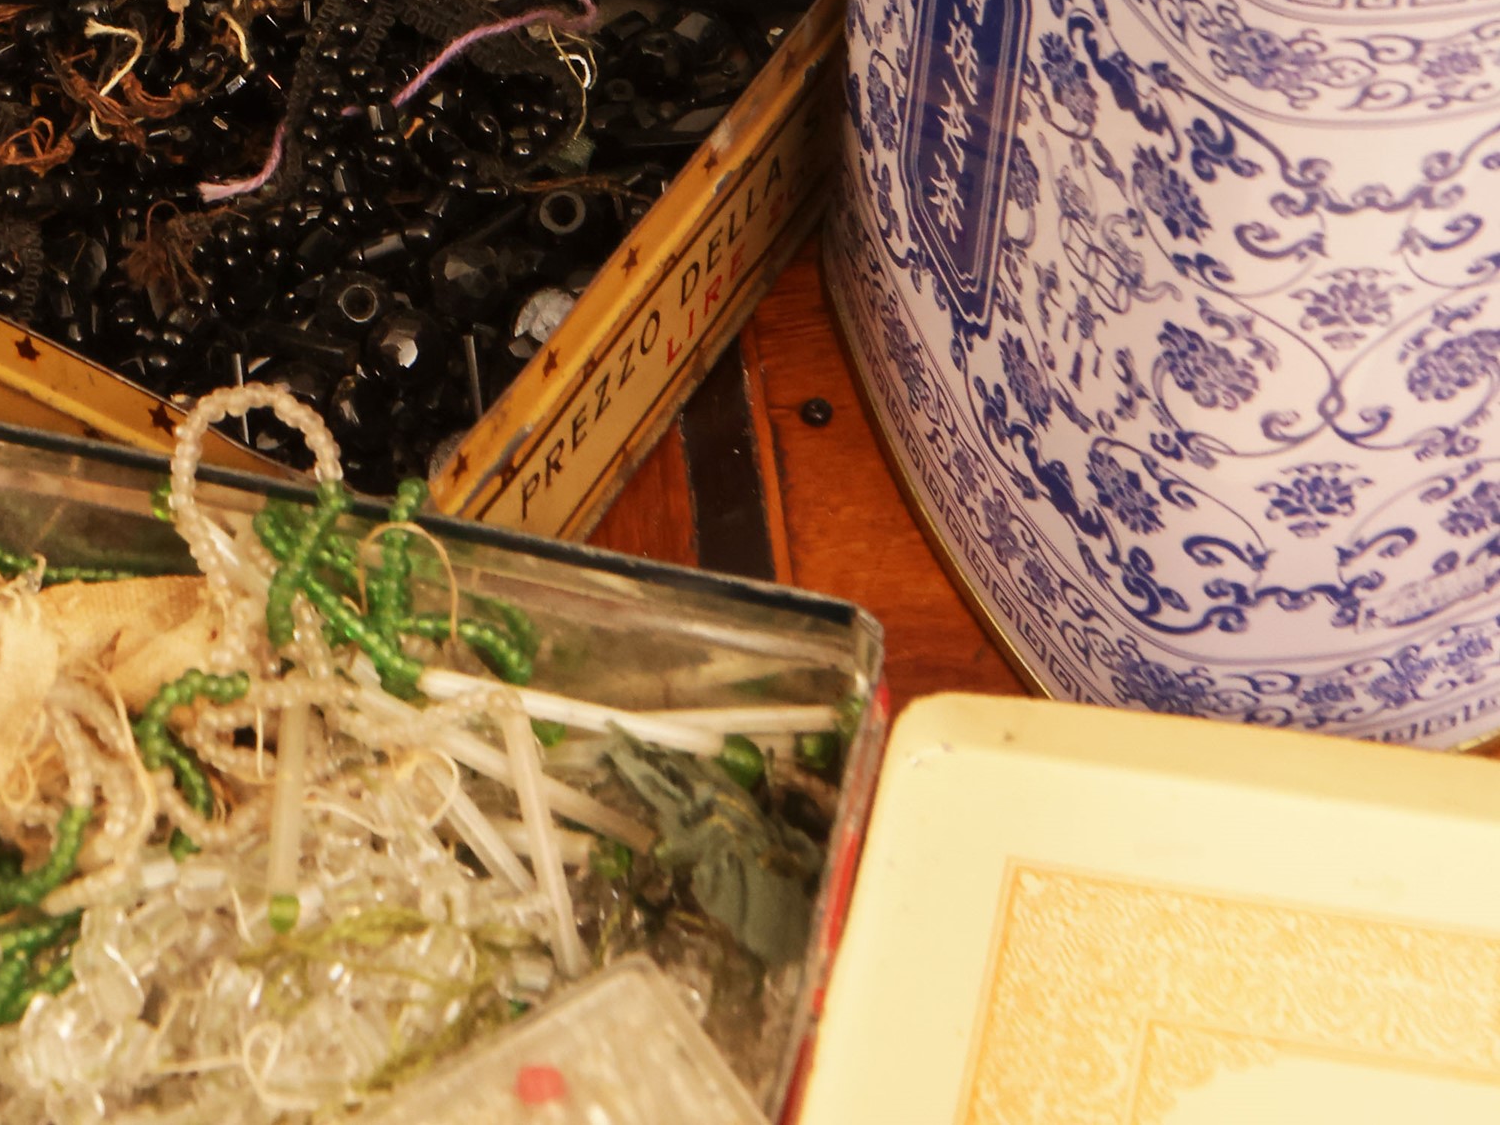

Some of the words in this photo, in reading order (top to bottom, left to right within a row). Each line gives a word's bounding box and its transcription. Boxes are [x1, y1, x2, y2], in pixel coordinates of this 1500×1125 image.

[521, 311, 661, 522] PREZZO
[679, 156, 783, 307] DELLA
[666, 253, 744, 368] LIRE
